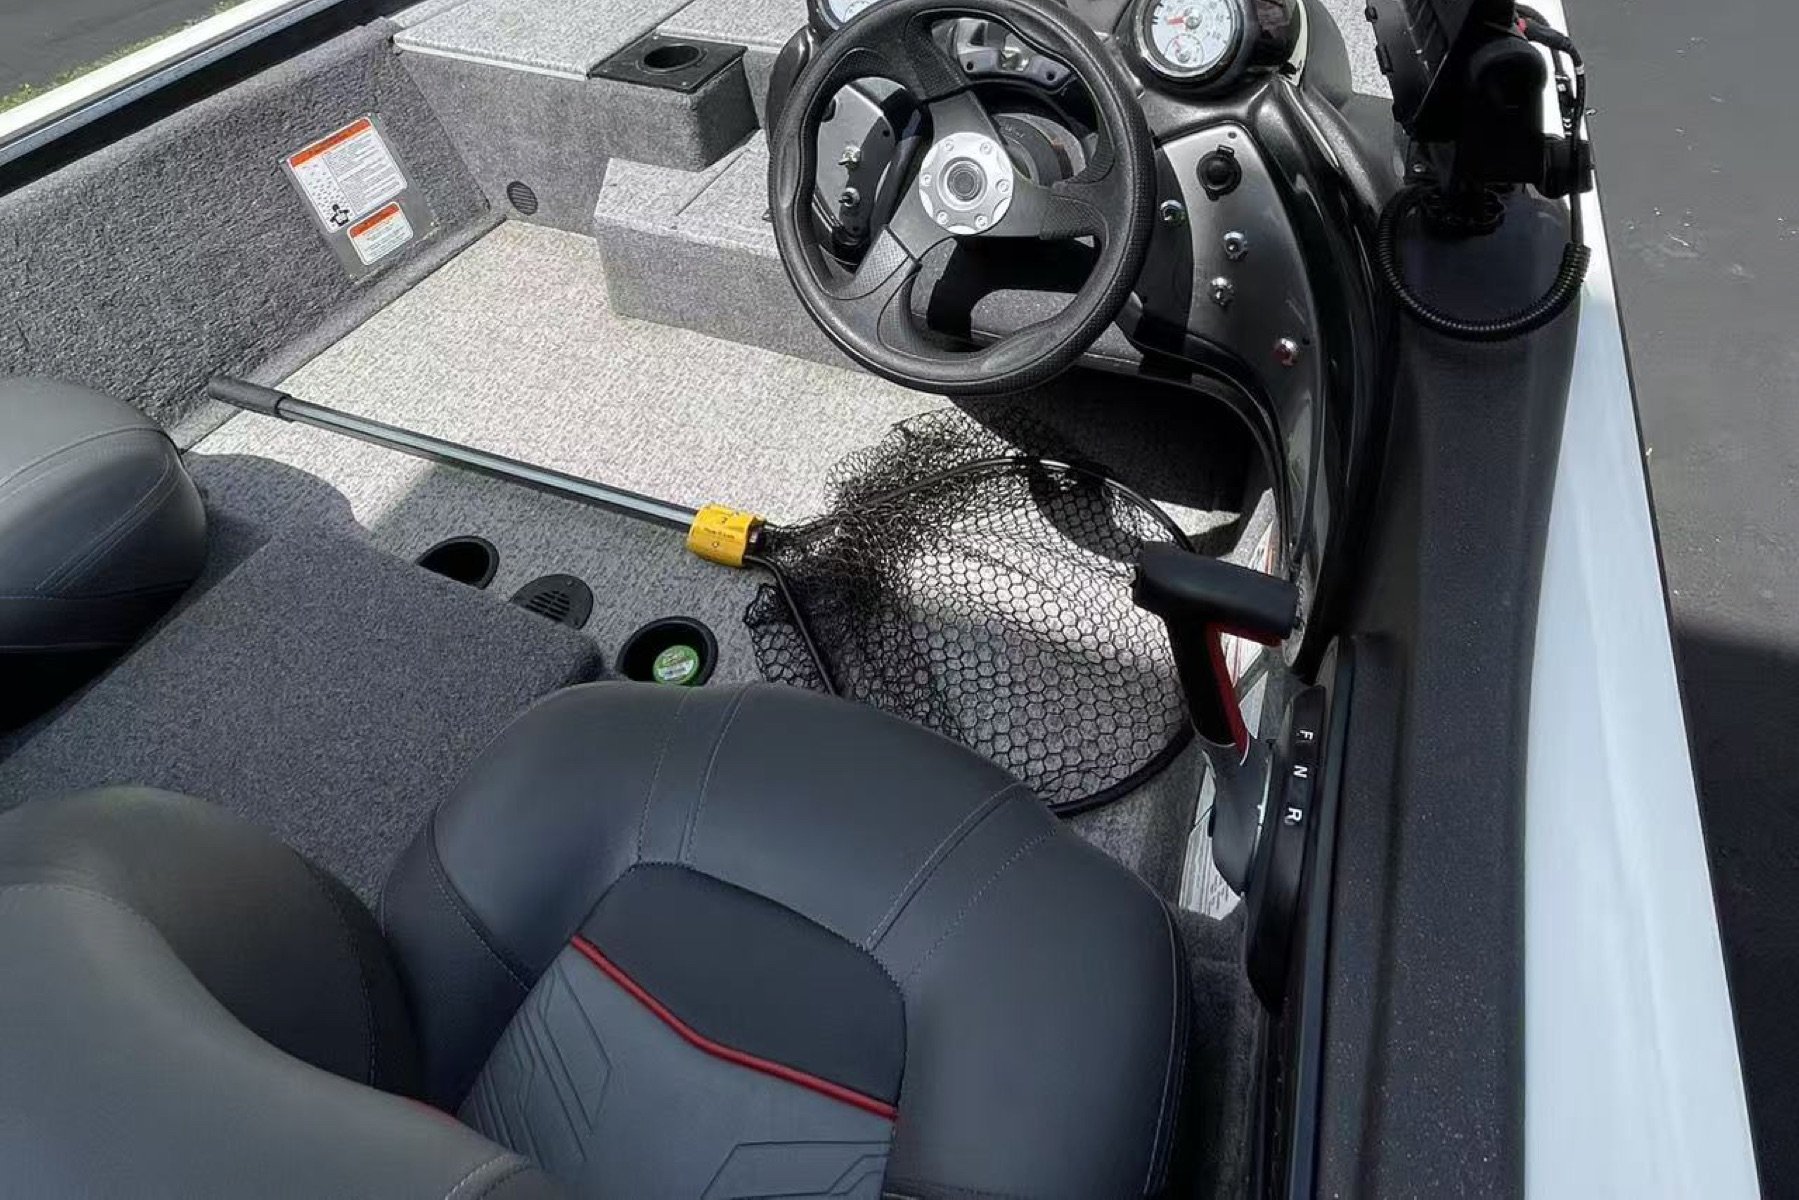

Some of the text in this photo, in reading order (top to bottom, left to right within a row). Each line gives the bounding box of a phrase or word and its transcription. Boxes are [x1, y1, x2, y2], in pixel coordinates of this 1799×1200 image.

[1288, 730, 1314, 823] F N R
